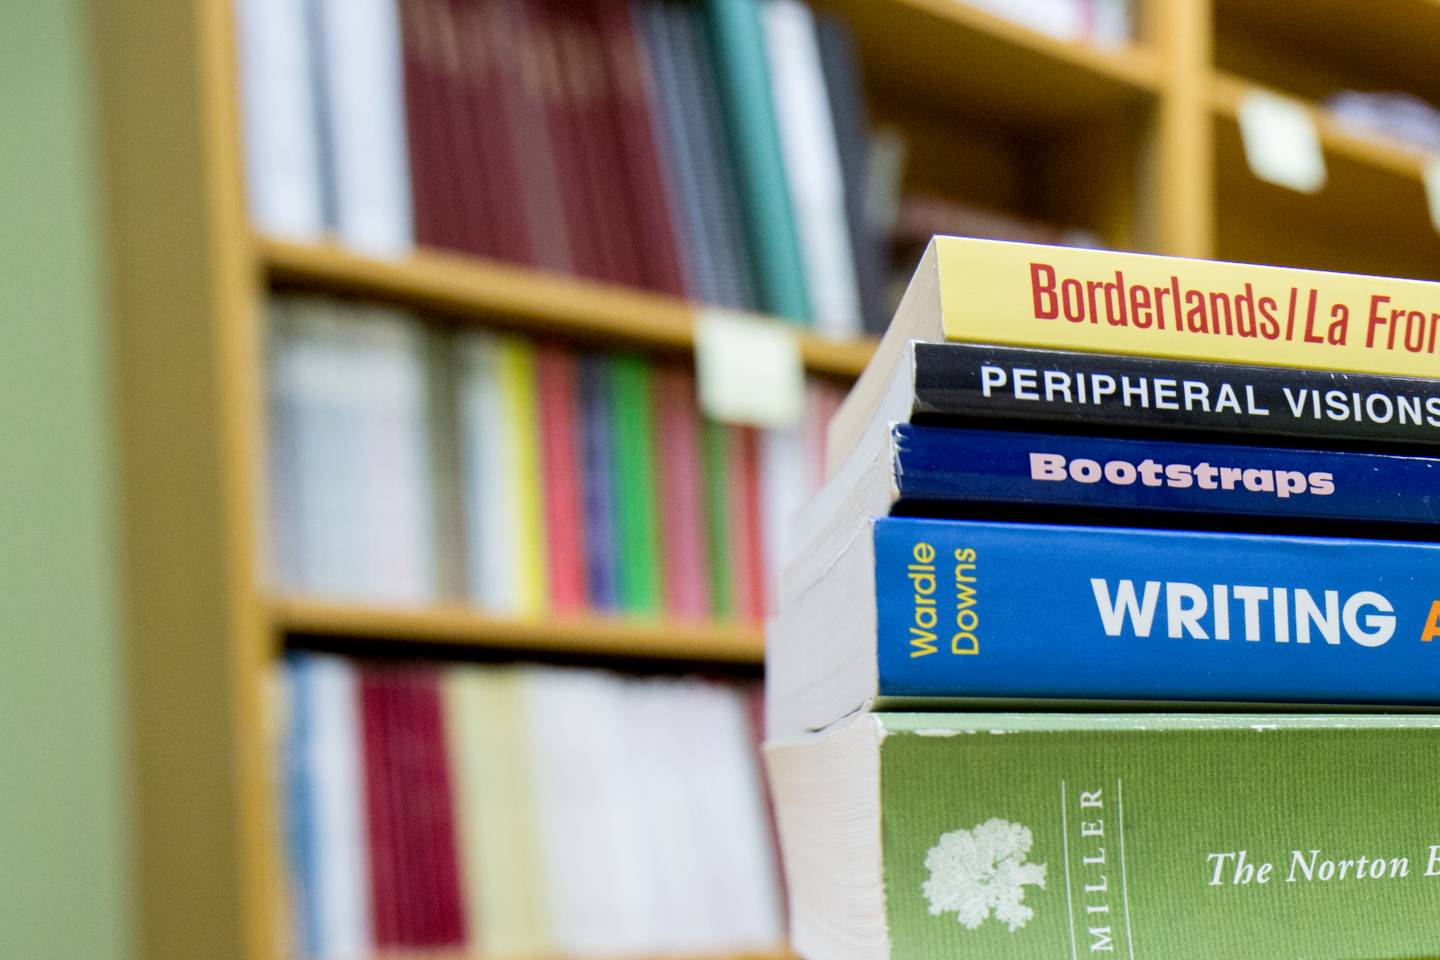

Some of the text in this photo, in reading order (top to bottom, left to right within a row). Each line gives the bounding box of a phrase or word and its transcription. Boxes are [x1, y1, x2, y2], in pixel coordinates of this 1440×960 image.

[981, 365, 1270, 416] PERIPHERAL
[1029, 452, 1335, 498] Bootstraps
[908, 542, 936, 659] Wardle
[952, 547, 979, 656] Downs
[1091, 578, 1397, 647] WRITING
[1079, 788, 1115, 953] MILLER
[1206, 851, 1273, 885] The
[1286, 849, 1409, 882] Norton
